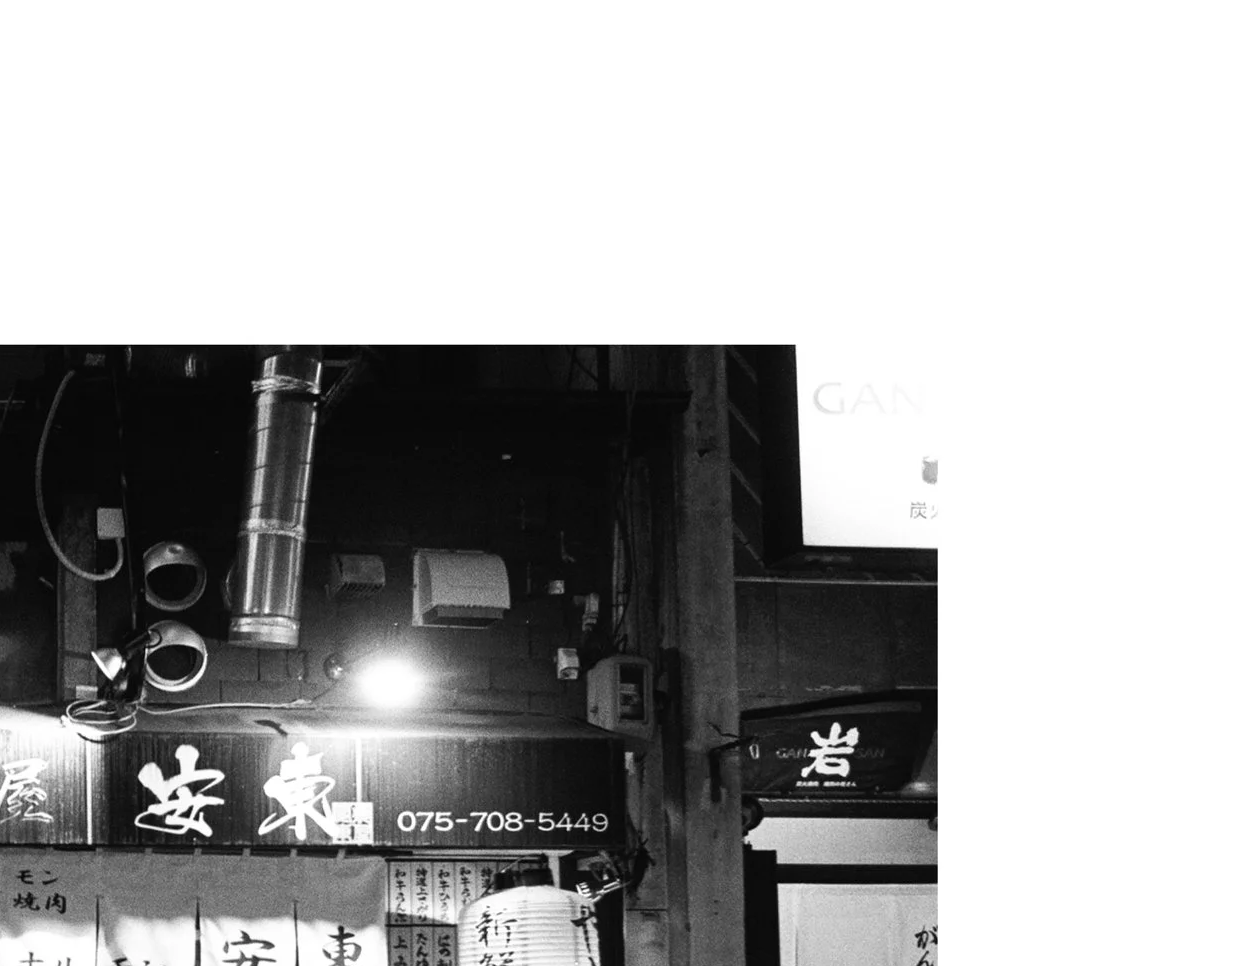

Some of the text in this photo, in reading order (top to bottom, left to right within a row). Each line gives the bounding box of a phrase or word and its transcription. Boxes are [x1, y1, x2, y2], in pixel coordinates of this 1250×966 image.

[801, 722, 859, 777] 岩
[133, 743, 342, 840] 安東
[398, 812, 608, 832] 075-708-5449
